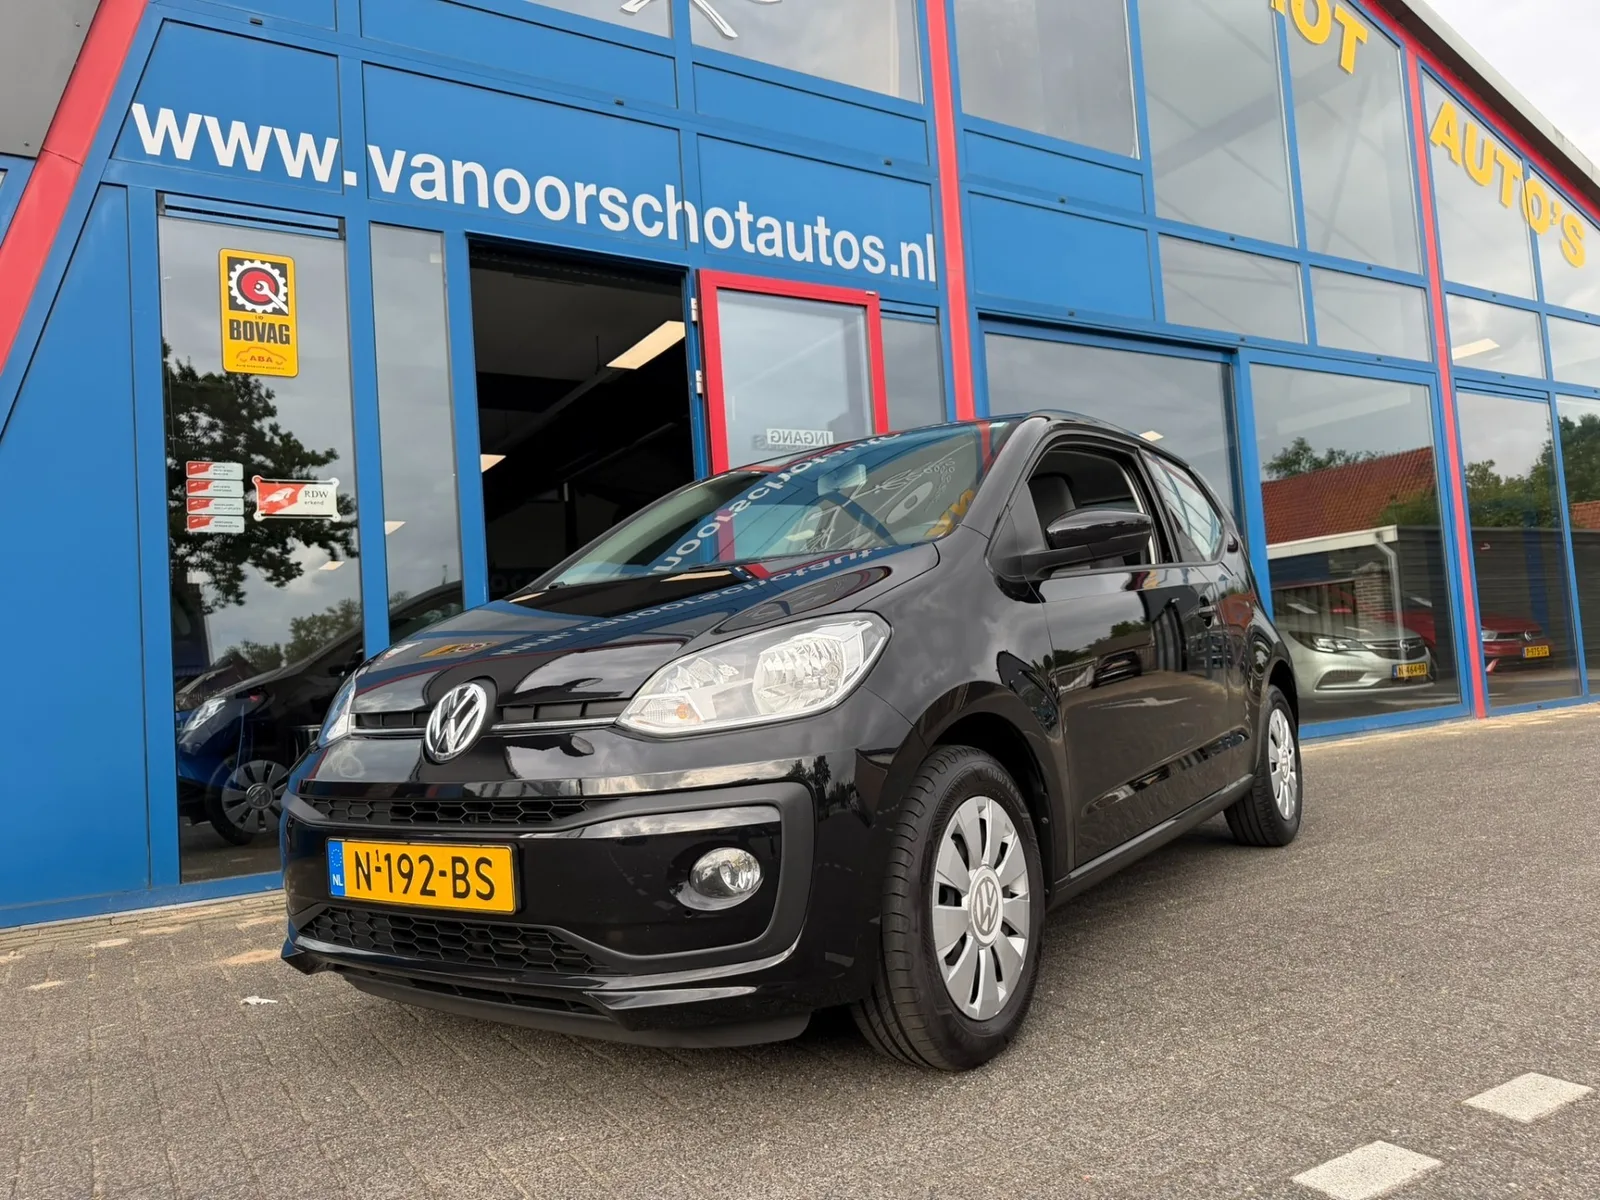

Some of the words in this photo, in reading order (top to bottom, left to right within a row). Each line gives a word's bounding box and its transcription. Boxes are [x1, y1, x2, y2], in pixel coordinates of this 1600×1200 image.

[1270, 0, 1368, 74] OT
[131, 102, 937, 283] www.vanoorschotautos.nl
[1429, 100, 1586, 268] AUTO'S
[228, 318, 291, 345] BOVAG
[249, 355, 273, 363] ABA
[304, 490, 329, 498] RDW
[332, 873, 344, 887] NL
[354, 849, 496, 901] N-192-BS
